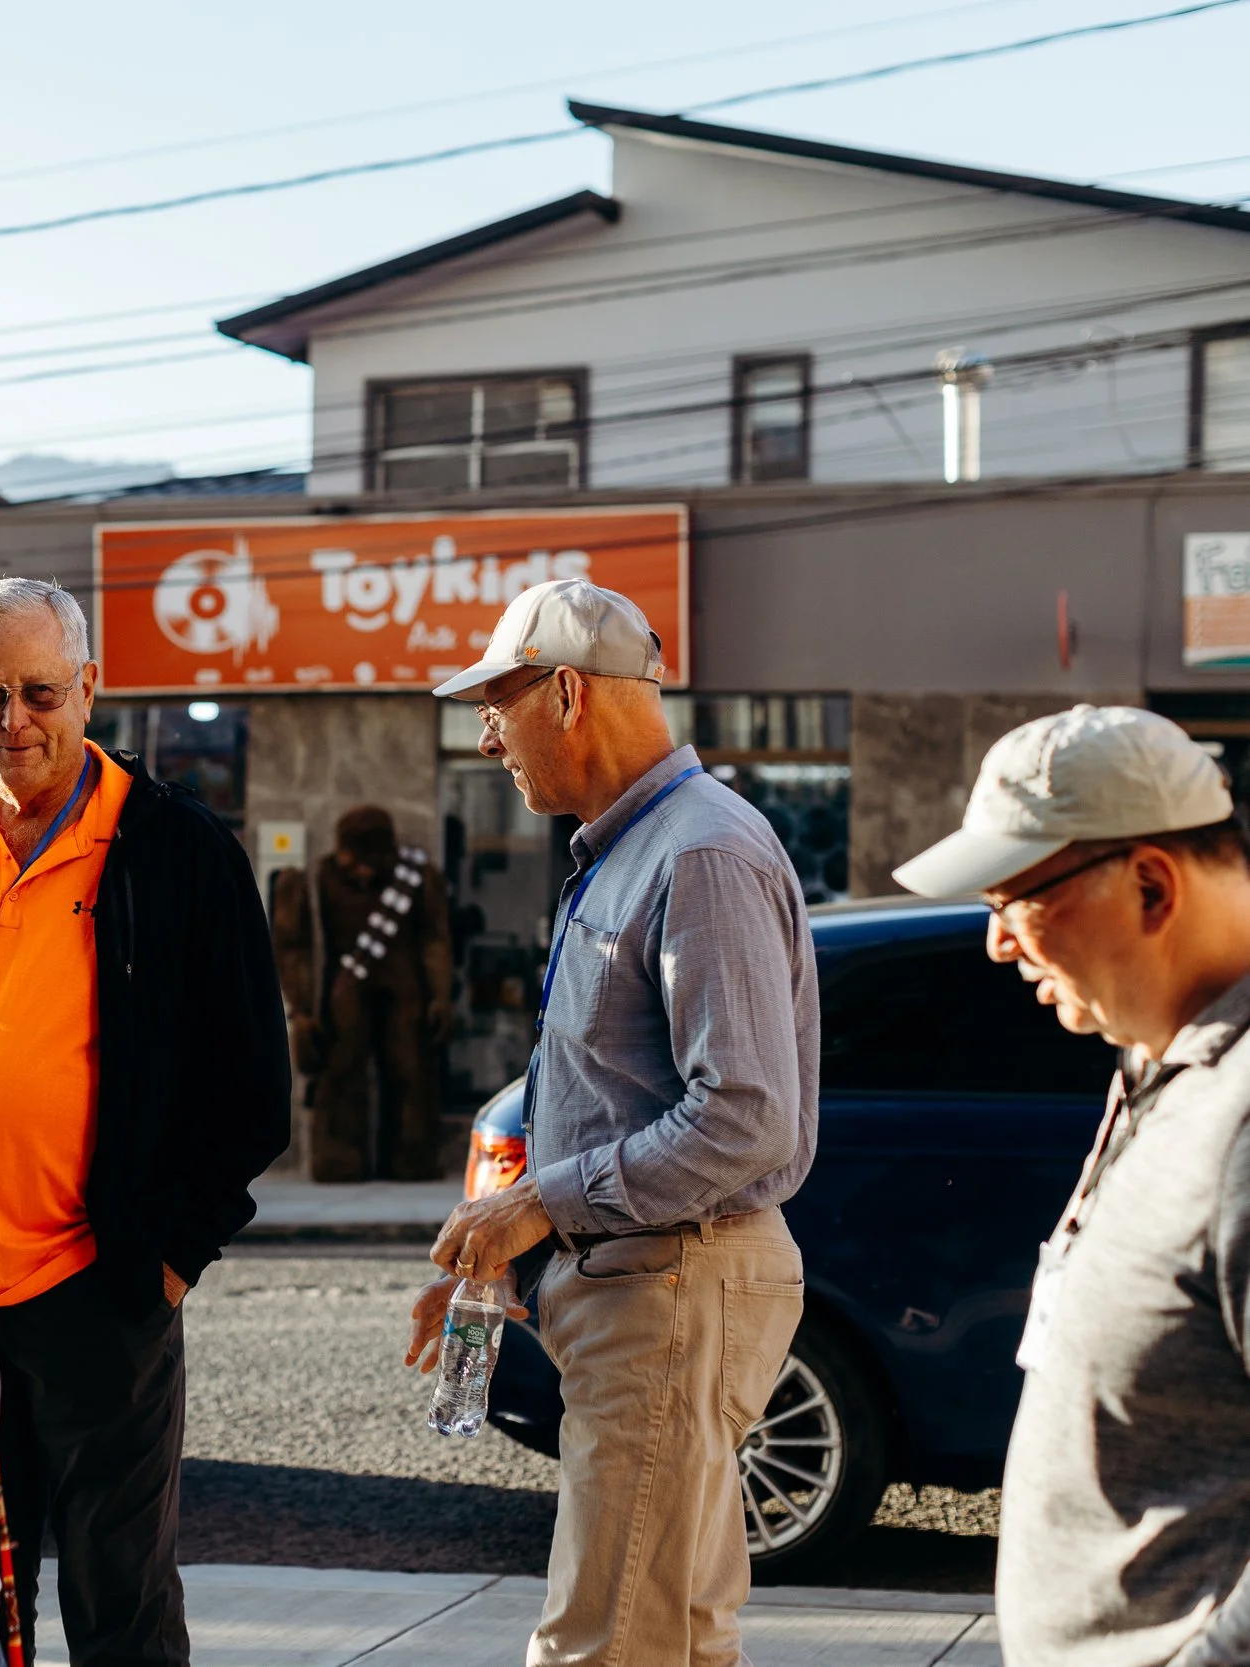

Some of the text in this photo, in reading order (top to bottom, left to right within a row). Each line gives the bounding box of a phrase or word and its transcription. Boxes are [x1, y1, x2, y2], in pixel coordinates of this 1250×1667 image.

[311, 535, 593, 625] Toykids
[1194, 538, 1250, 597] Fre
[467, 1328, 486, 1338] 100%
